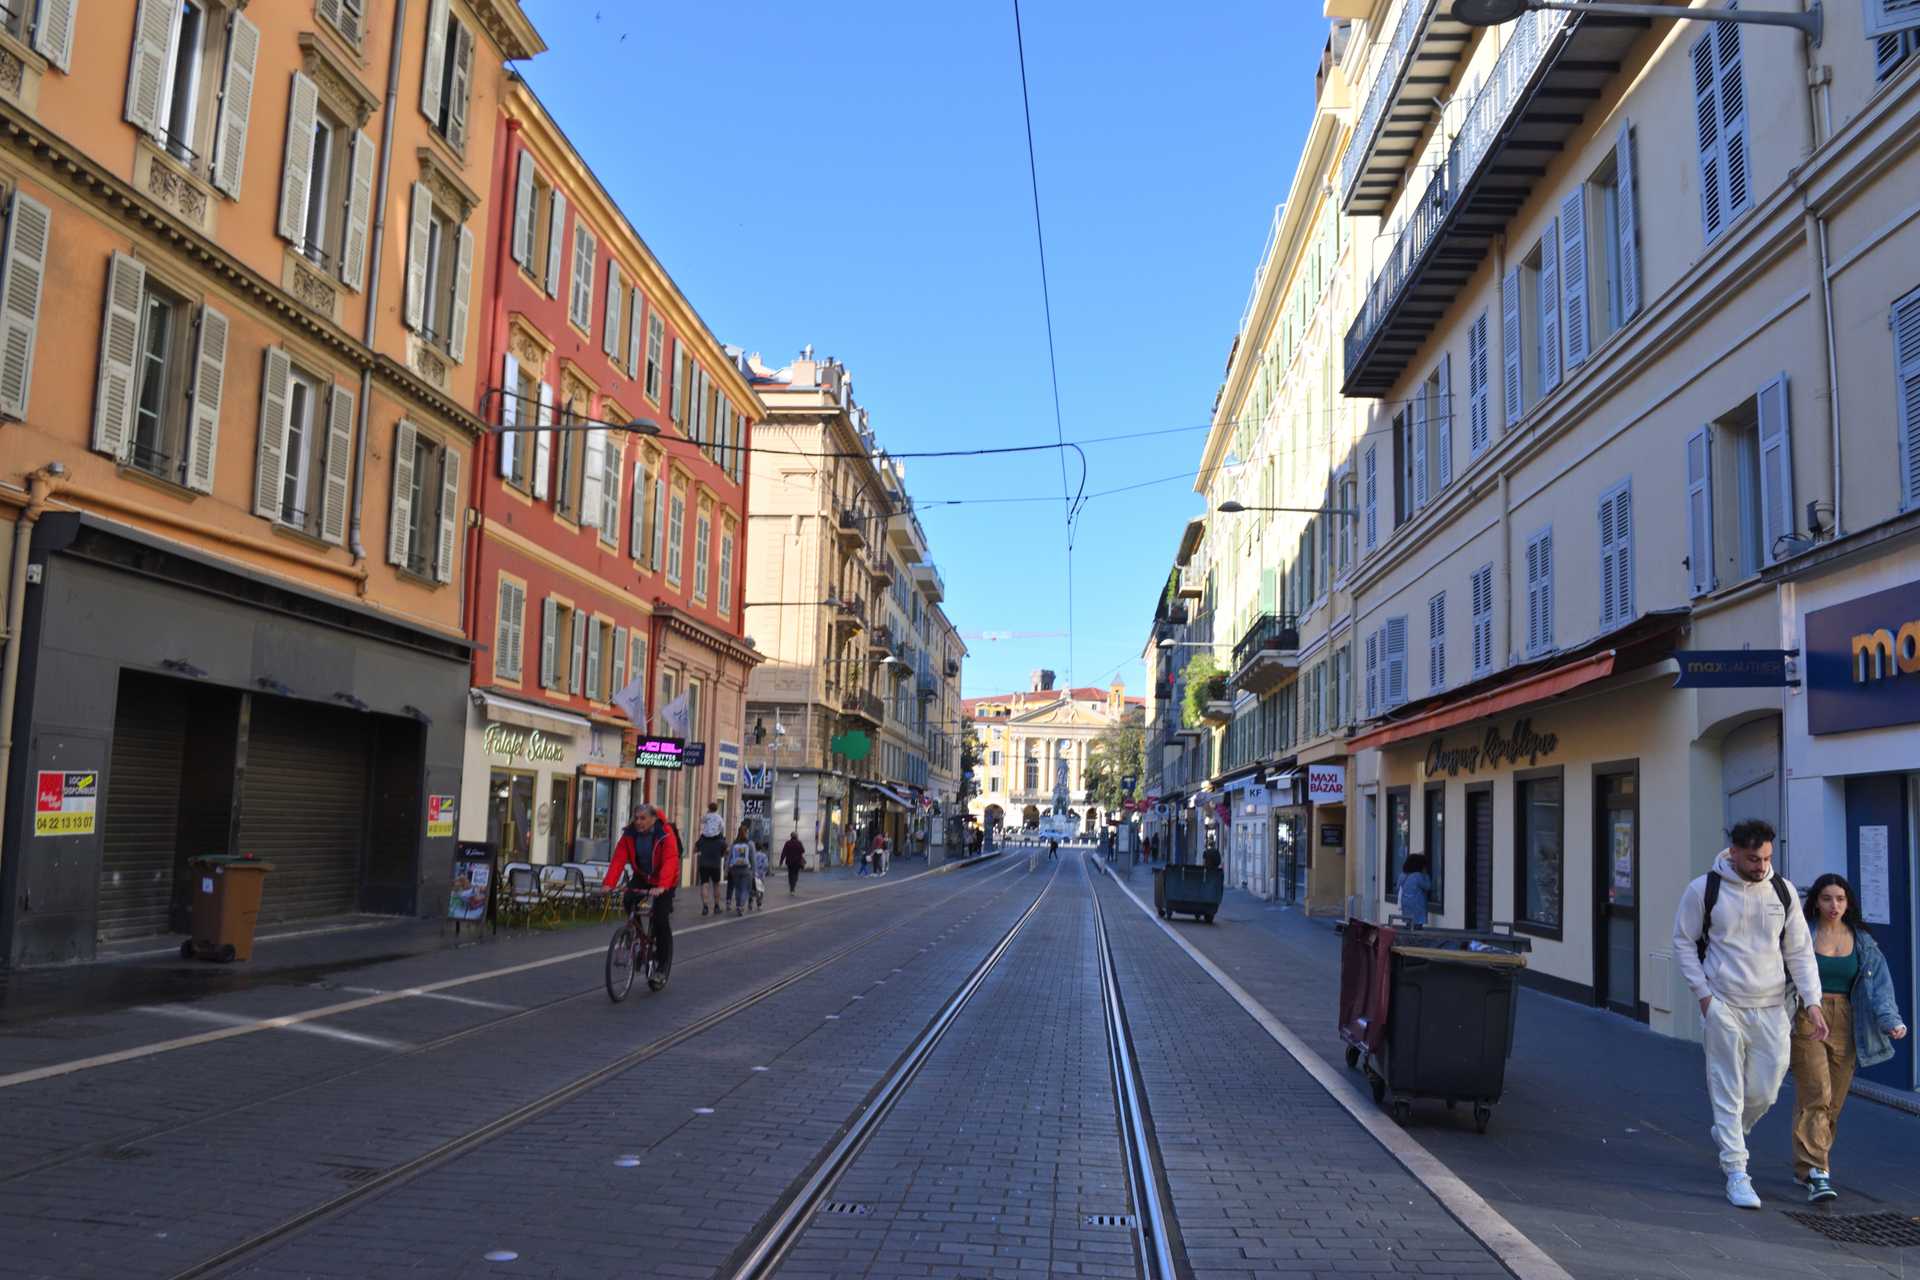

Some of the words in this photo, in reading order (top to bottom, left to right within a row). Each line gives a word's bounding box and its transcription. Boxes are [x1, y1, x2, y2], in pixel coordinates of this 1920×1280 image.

[483, 723, 524, 766] Falafel
[525, 730, 564, 763] Sahara
[1310, 773, 1338, 782] MAXI
[1310, 783, 1343, 793] BAZAR
[37, 817, 47, 830] 04
[49, 816, 59, 829] 22
[62, 816, 71, 829] 13
[73, 815, 82, 828] 13
[83, 815, 93, 828] 07
